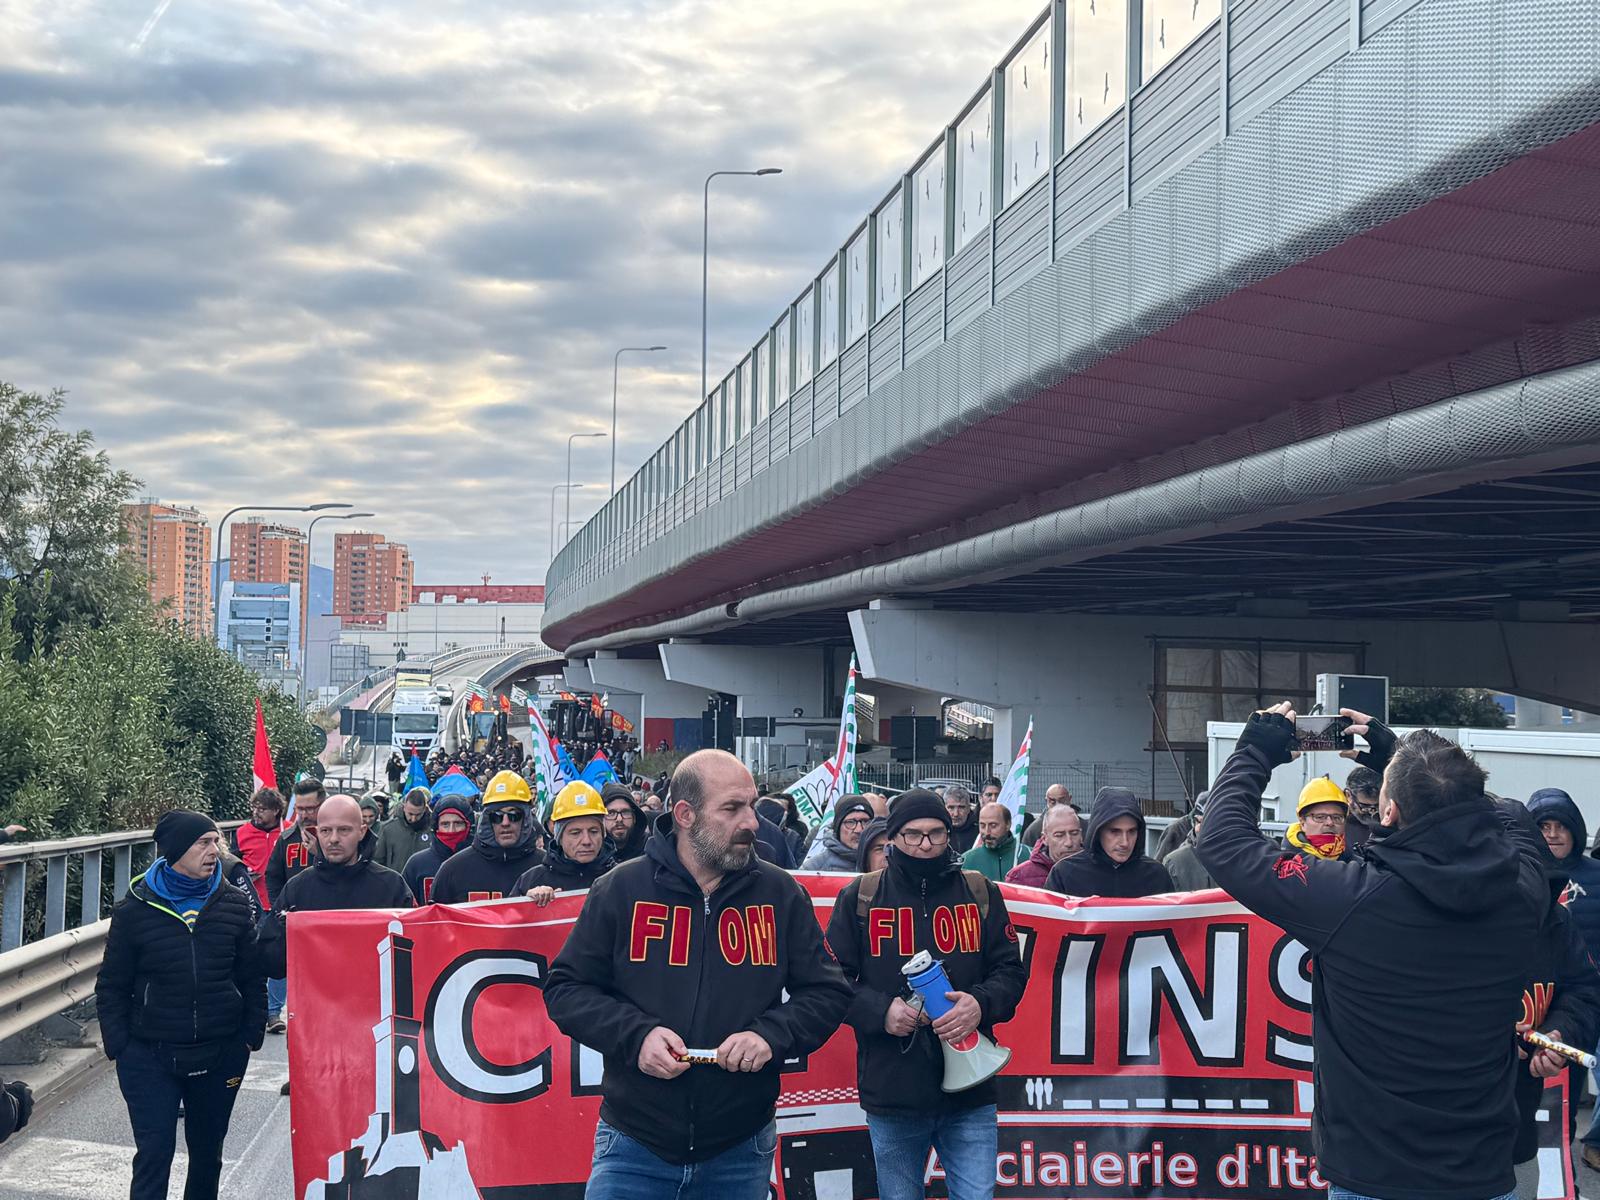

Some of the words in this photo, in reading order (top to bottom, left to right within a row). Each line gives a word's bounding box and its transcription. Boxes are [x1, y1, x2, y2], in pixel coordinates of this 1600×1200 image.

[791, 787, 822, 828] FIM-C
[923, 1140, 1198, 1188] Aciaierie
[1216, 1142, 1330, 1191] d'Ita
